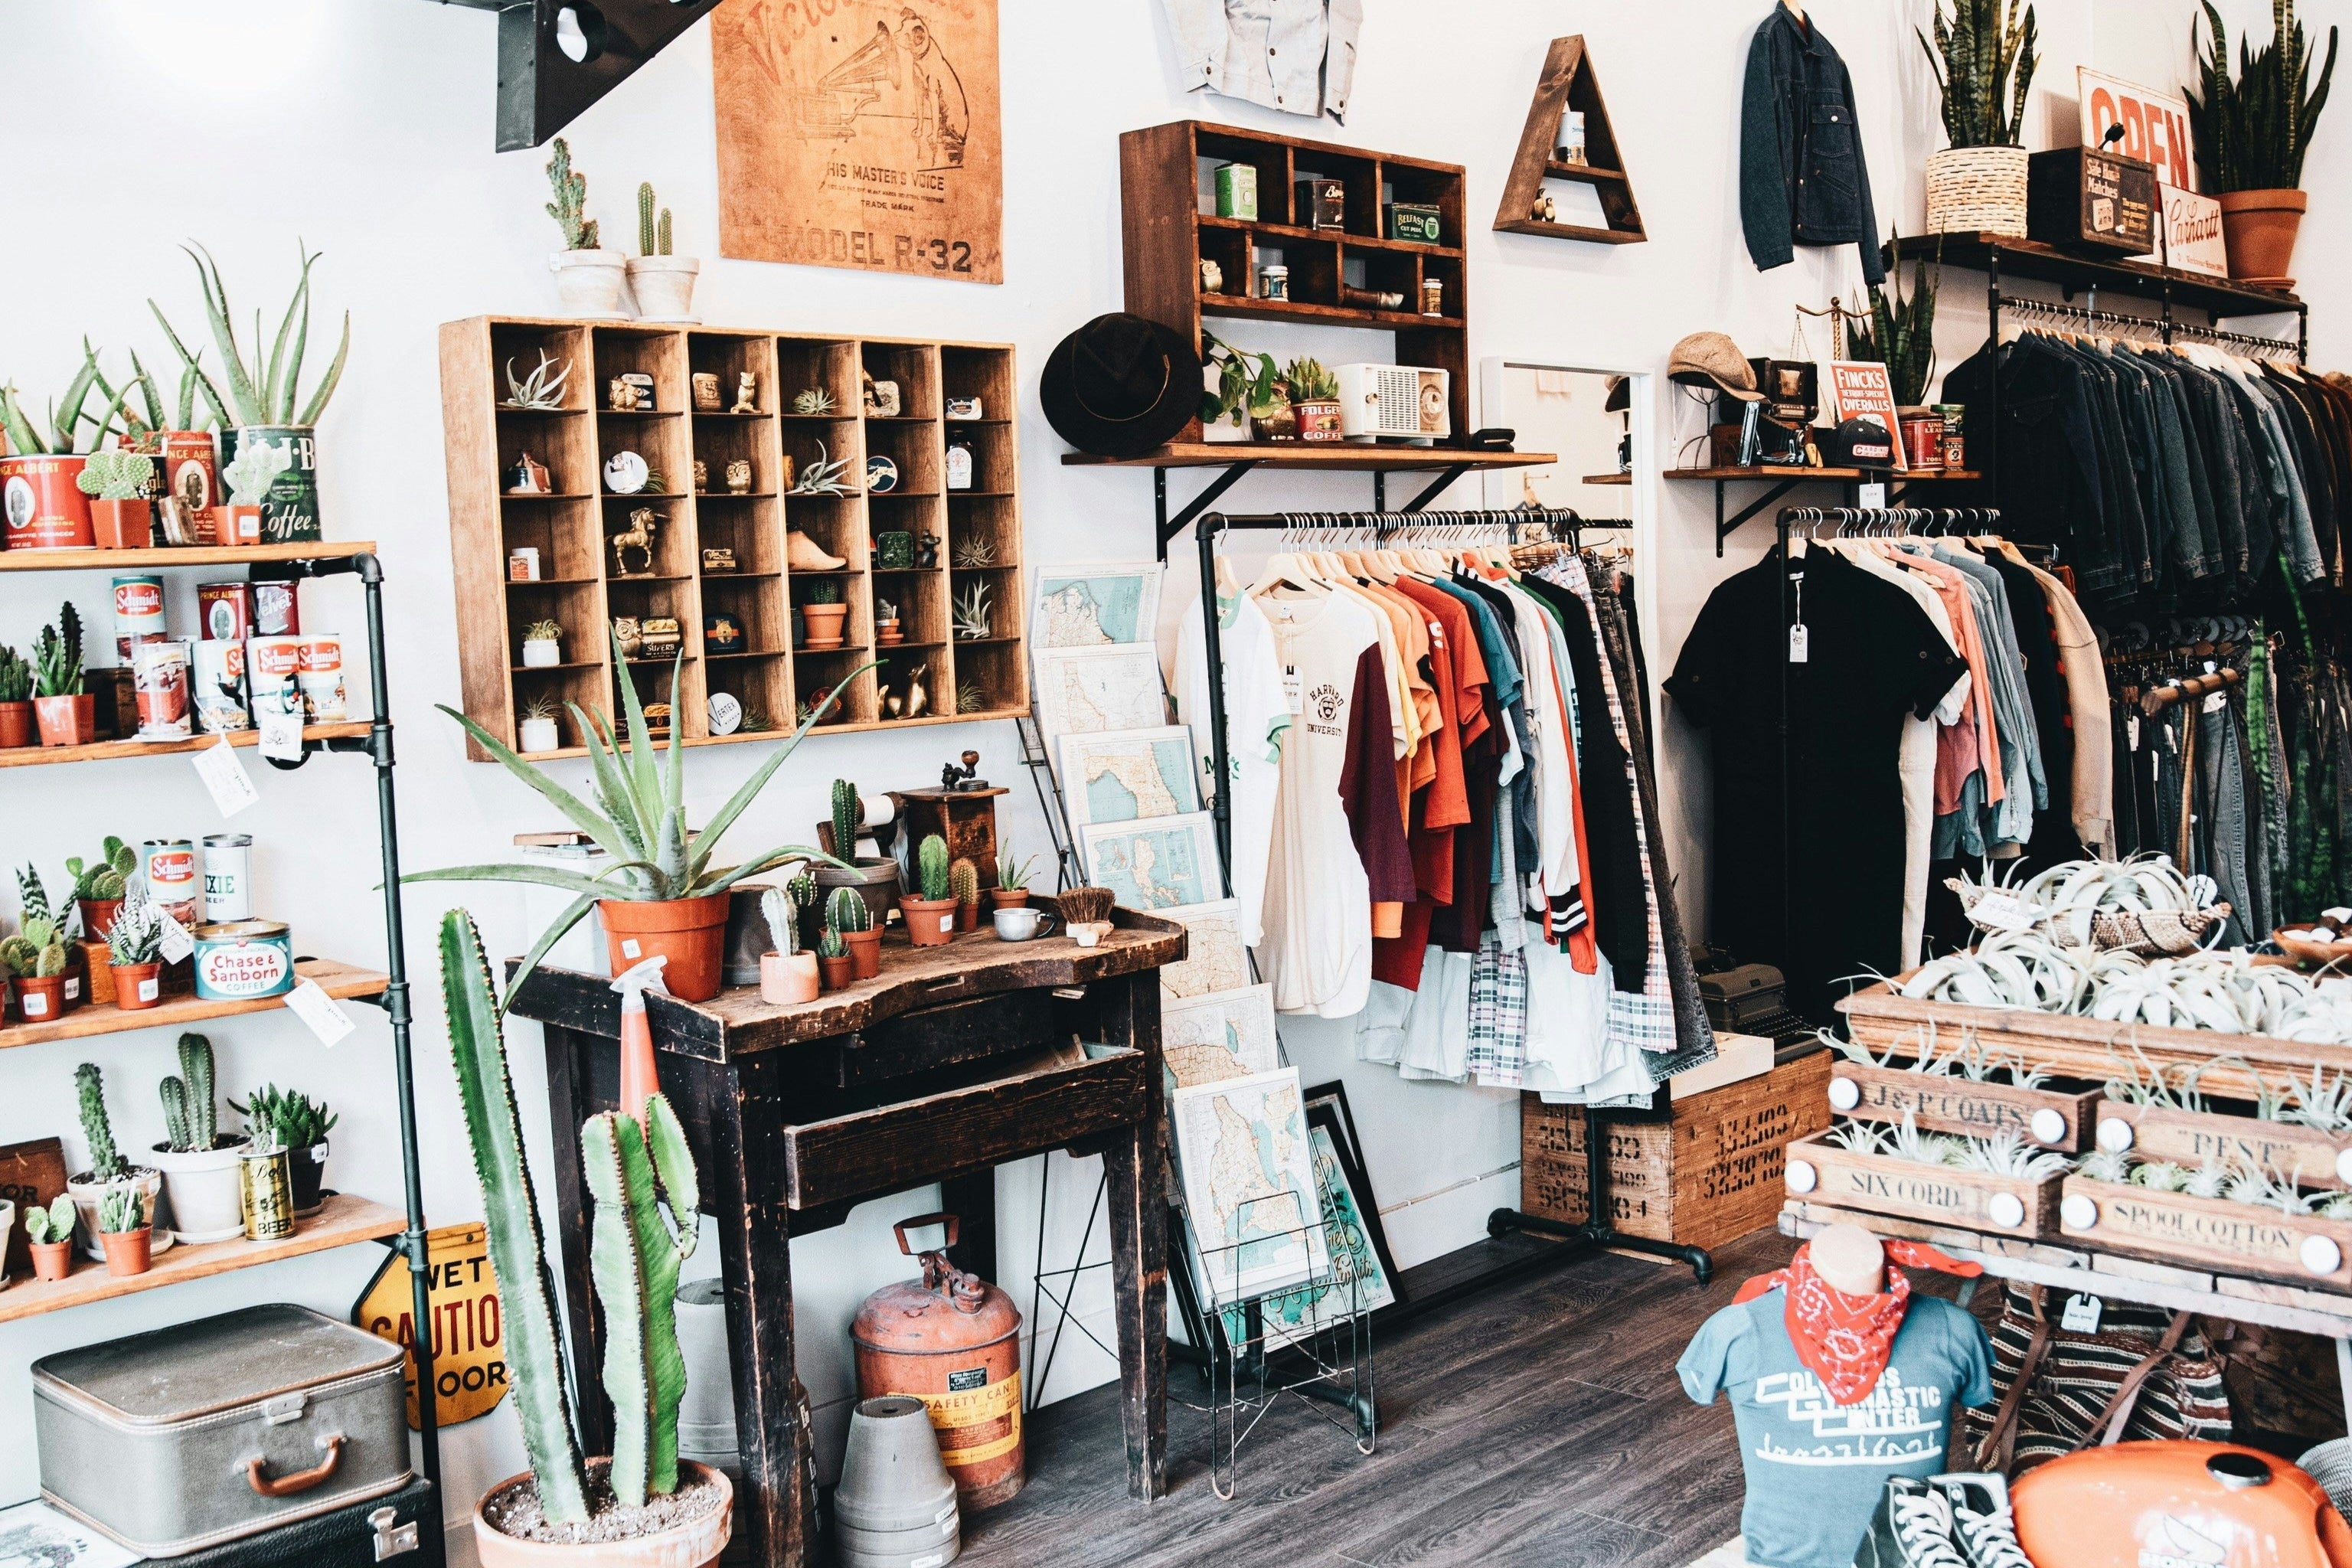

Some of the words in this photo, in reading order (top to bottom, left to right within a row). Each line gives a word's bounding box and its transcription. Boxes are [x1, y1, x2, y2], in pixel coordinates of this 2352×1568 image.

[2091, 87, 2190, 191] OPEN
[827, 162, 848, 178] HIS
[853, 164, 907, 185] MASTER'S
[911, 172, 945, 191] VOICE
[2087, 176, 2118, 199] Matches
[861, 199, 888, 210] TRADE
[890, 201, 915, 212] MARK
[1397, 214, 1425, 229] BELFAST
[2165, 199, 2220, 247] Carhartt
[894, 234, 972, 273] R-32
[1835, 368, 1886, 389] FINCK'S
[1841, 397, 1891, 413] OVERALLS
[15, 462, 60, 475] ALBERT
[261, 503, 312, 539] Coffee
[116, 586, 159, 611] Schmidt
[200, 590, 220, 600] PRINCE
[299, 645, 340, 668] Schmidt
[1309, 684, 1344, 707] HARVARD
[214, 955, 265, 969] Chase
[210, 967, 279, 982] Sanborn
[227, 981, 266, 992] COFFEE
[1941, 1095, 2025, 1127] COATS
[1539, 1125, 1641, 1160] COFEE
[1851, 1171, 1890, 1198] SIX
[1897, 1178, 1960, 1208] CORD
[258, 1217, 293, 1234] BEER
[2115, 1204, 2188, 1231] SPOOL
[2196, 1217, 2291, 1248] COTTON
[427, 1255, 487, 1292] WET
[405, 1360, 507, 1398] FOOR
[923, 1395, 978, 1410] SAFETY
[987, 1383, 1010, 1400] CAN
